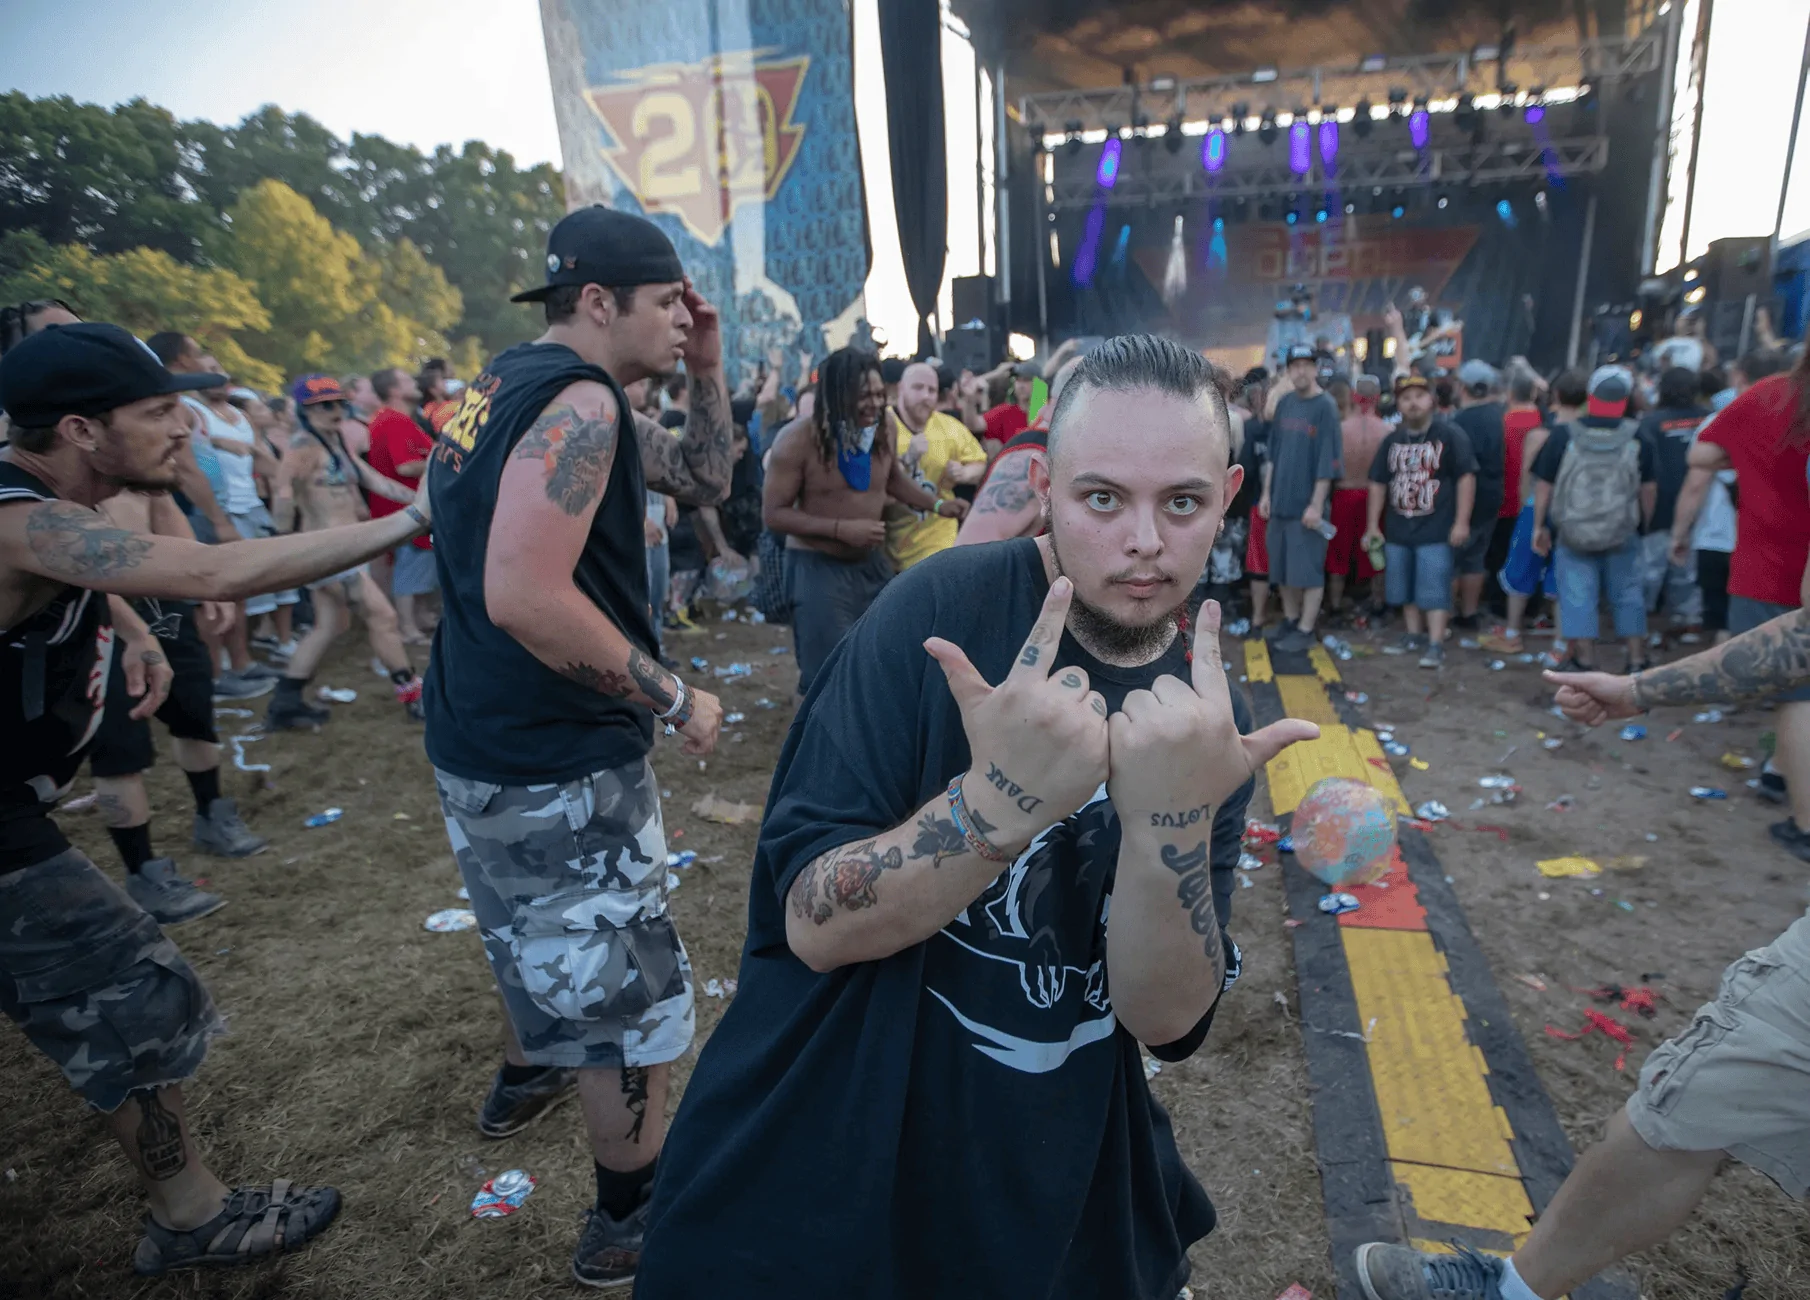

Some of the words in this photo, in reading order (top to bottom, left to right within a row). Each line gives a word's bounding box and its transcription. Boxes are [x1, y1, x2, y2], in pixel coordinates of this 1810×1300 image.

[632, 79, 777, 197] 20
[984, 760, 1044, 814] DARK
[1151, 804, 1212, 828] LOTUS
